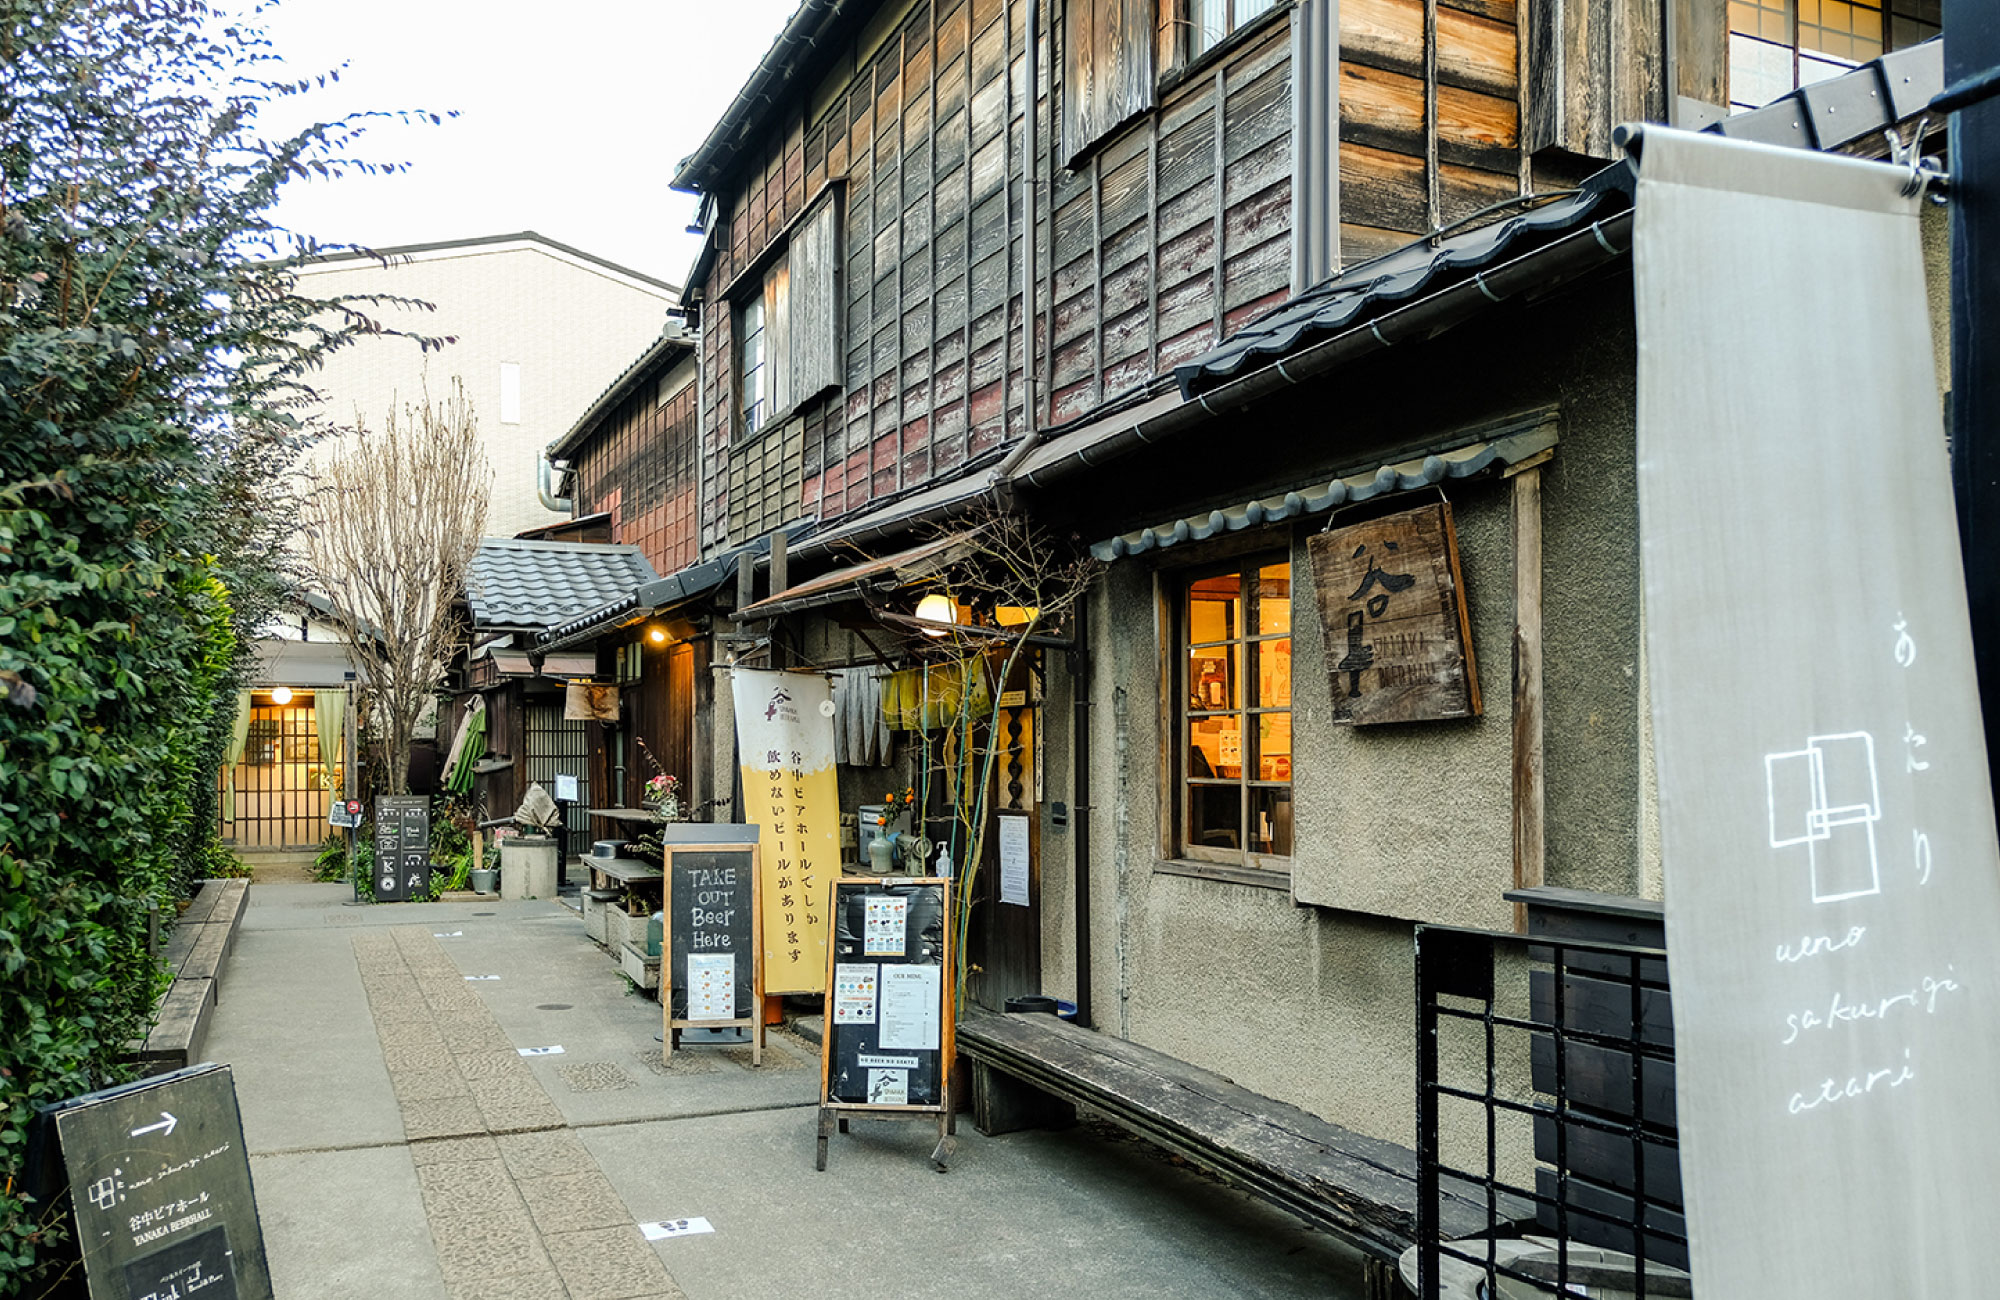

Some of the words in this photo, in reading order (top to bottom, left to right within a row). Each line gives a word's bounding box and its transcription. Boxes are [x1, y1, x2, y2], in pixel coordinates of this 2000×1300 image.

[766, 750, 802, 964] 飲めないビールがあります
[687, 868, 737, 888] TAKE
[691, 907, 735, 927] Beer
[698, 889, 734, 907] OUT
[692, 930, 732, 948] Here
[1776, 925, 1867, 963] ueno
[1788, 1049, 1914, 1114] atari
[129, 1190, 210, 1232] 谷中ビアホール
[133, 1223, 170, 1247] YANAKA
[170, 1208, 213, 1231] BEERHALL
